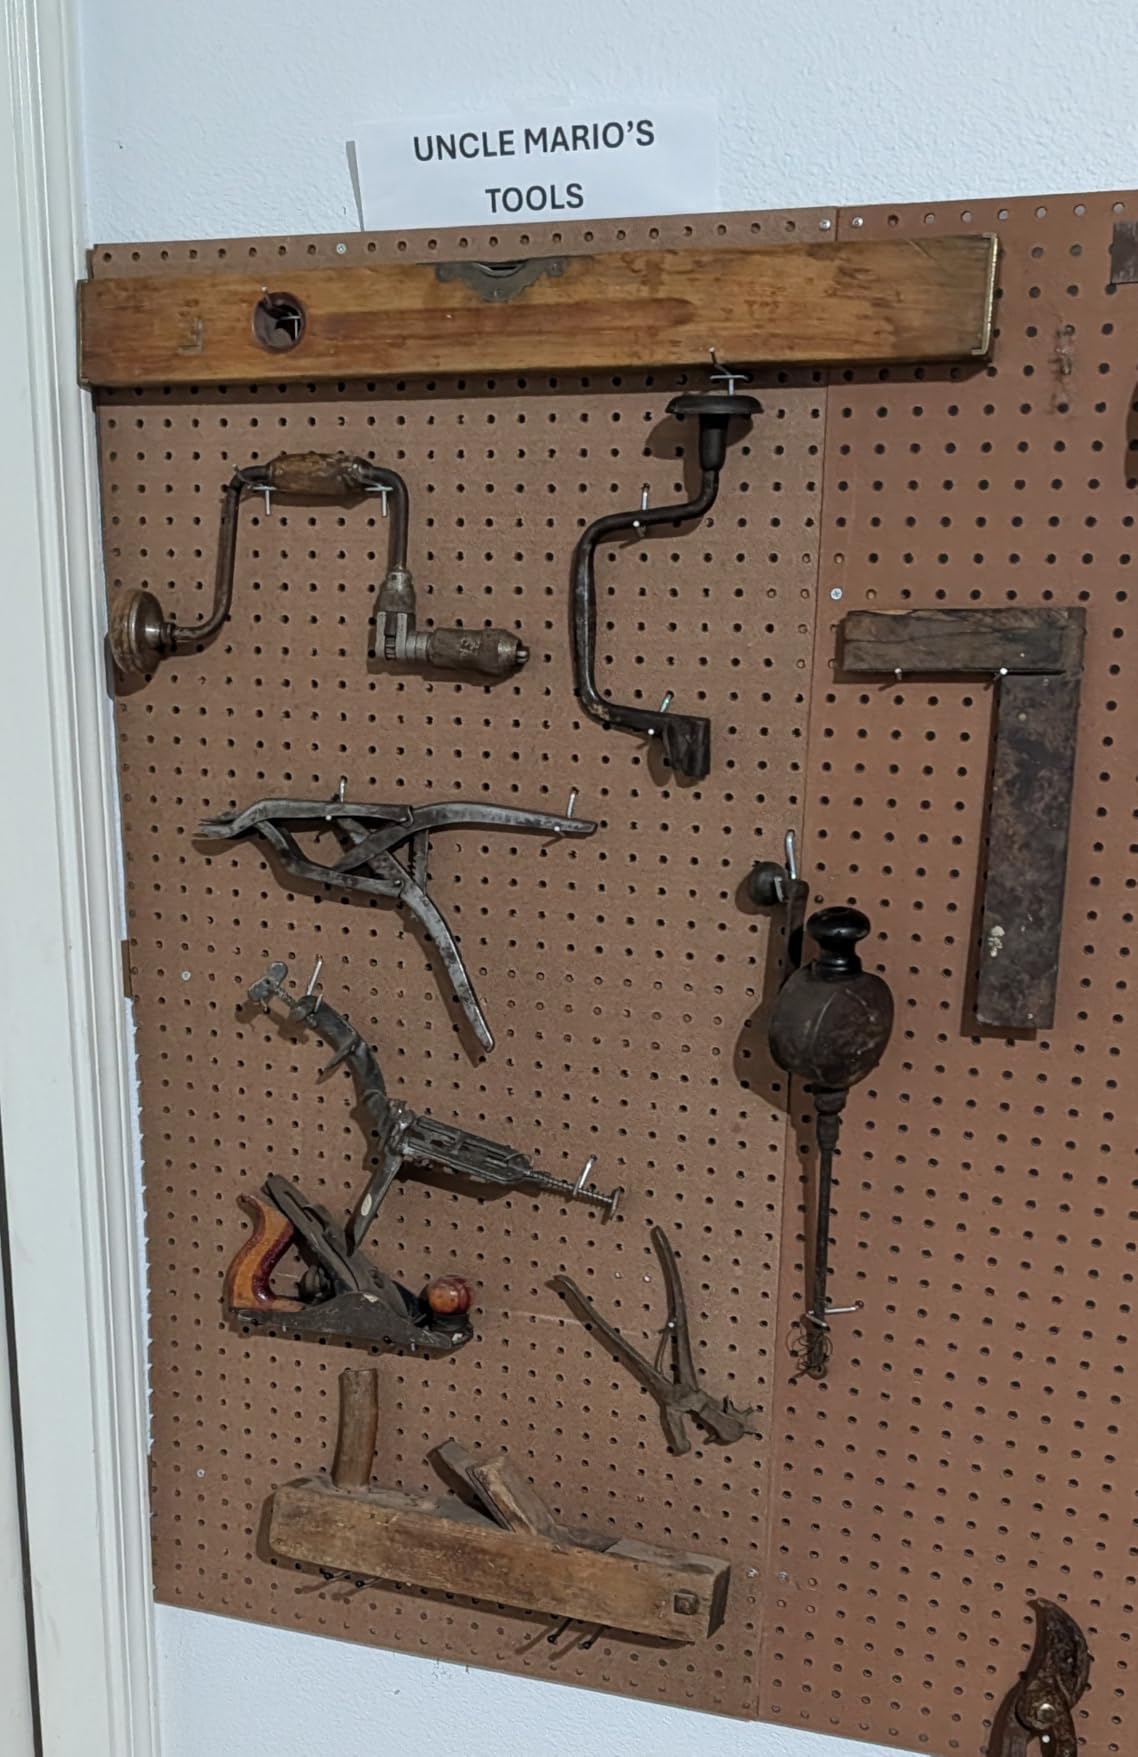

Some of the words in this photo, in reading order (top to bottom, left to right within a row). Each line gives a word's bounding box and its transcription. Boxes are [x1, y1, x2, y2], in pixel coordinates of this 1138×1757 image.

[413, 129, 515, 162] UNCLE
[524, 119, 655, 154] MARIO'S
[485, 183, 584, 213] TOOLS
